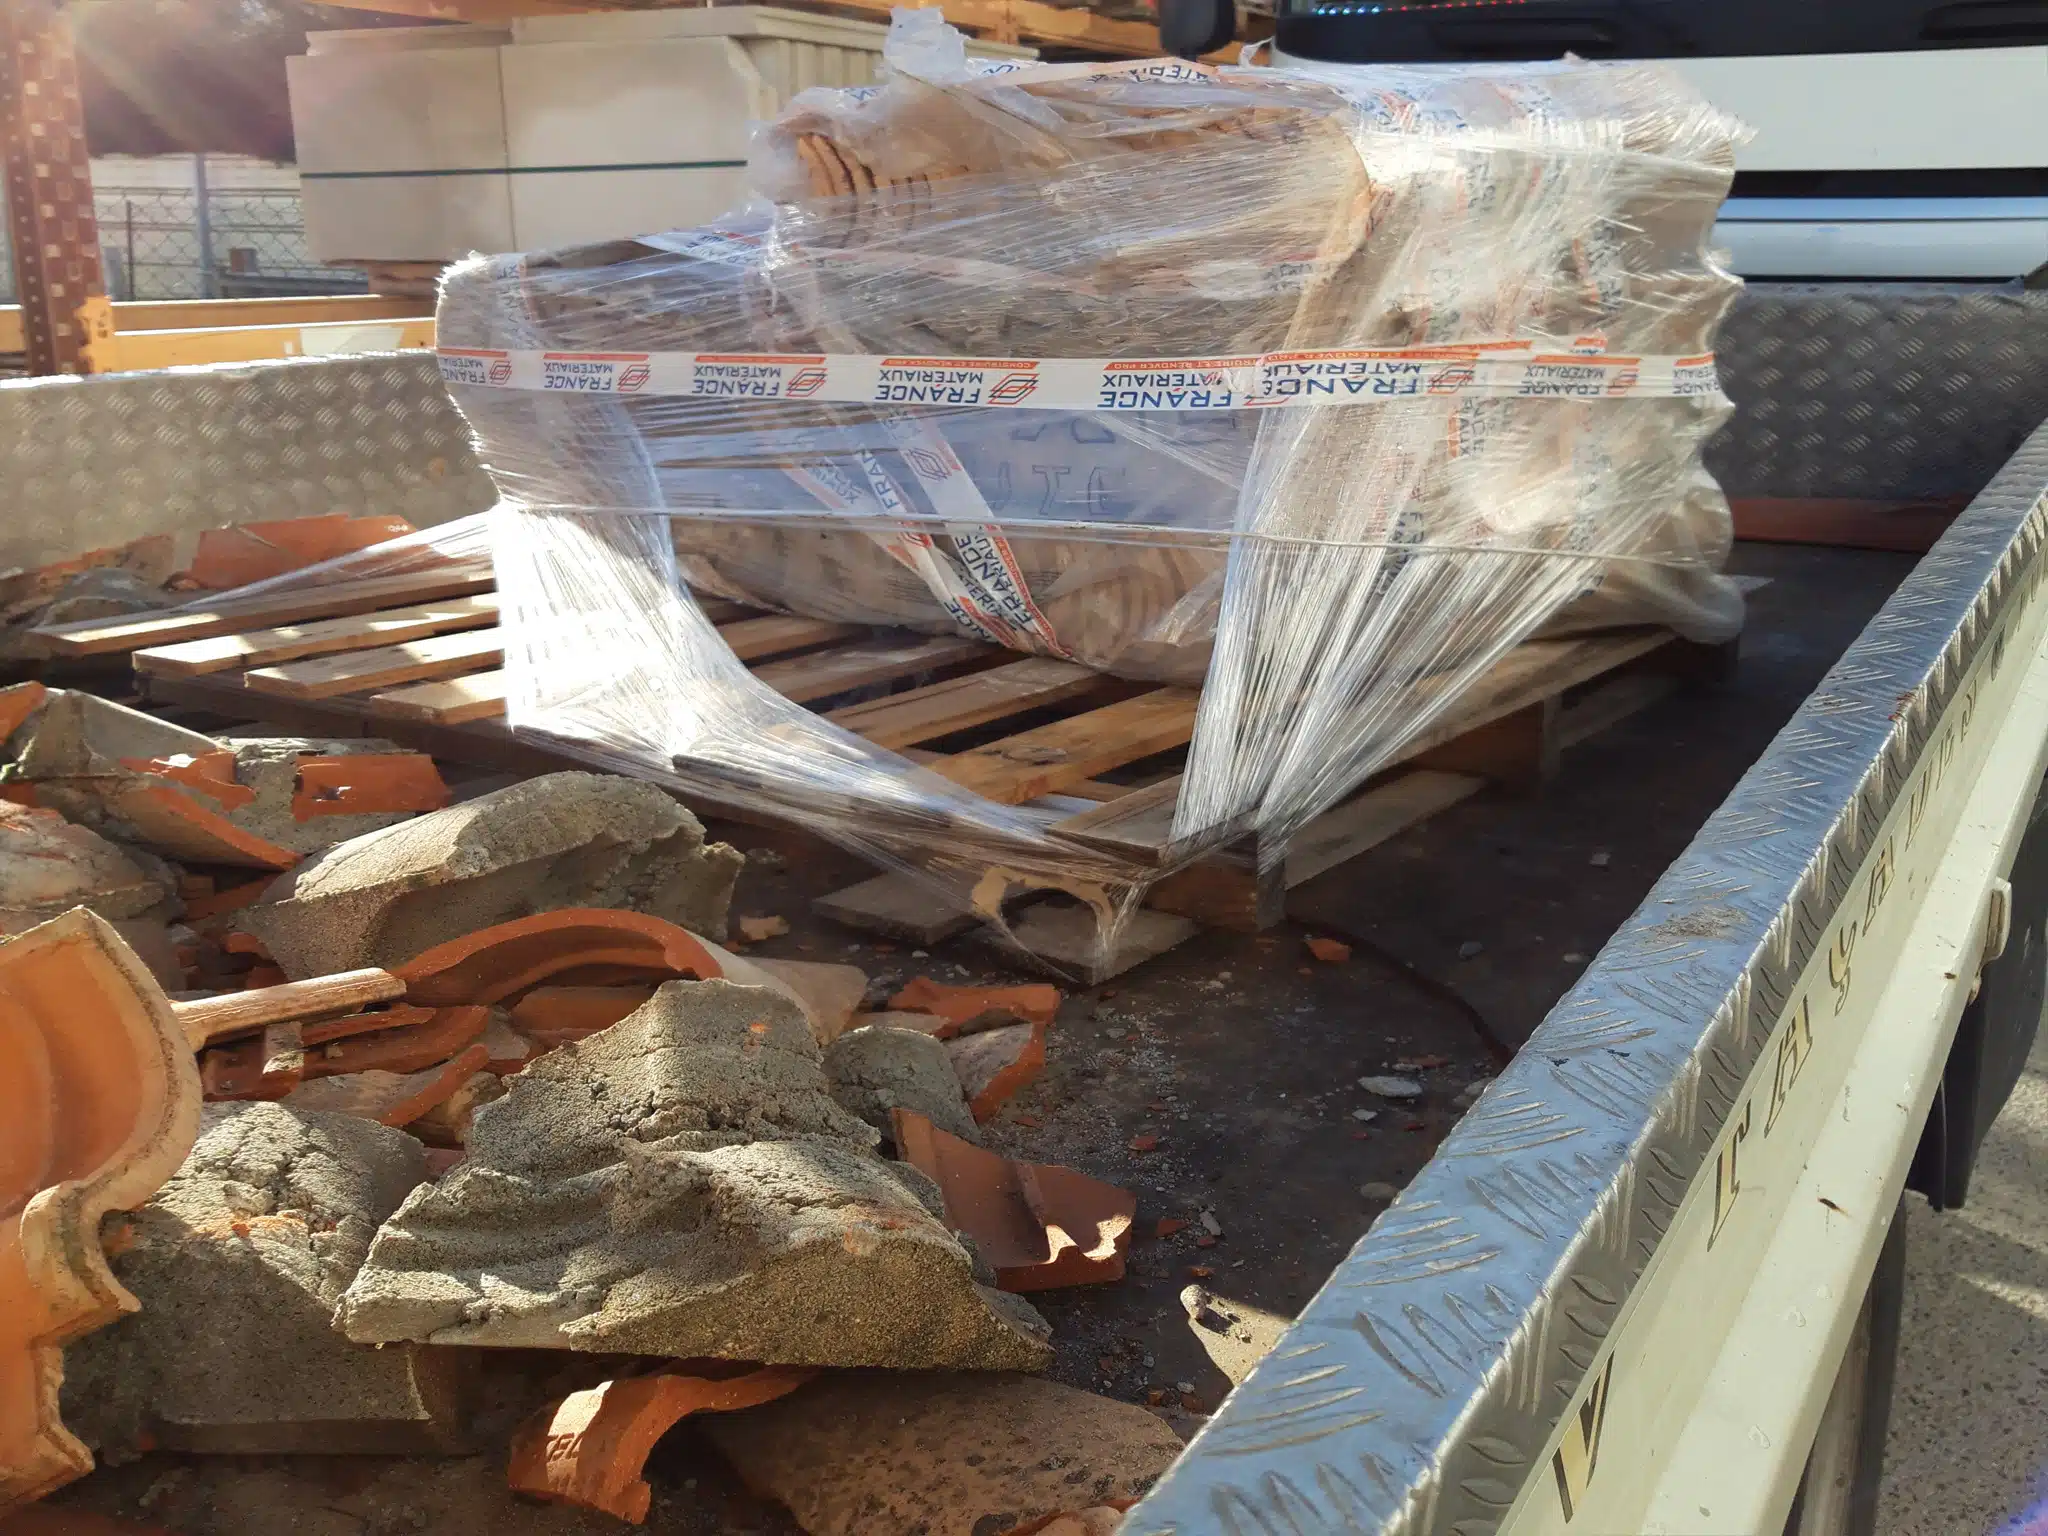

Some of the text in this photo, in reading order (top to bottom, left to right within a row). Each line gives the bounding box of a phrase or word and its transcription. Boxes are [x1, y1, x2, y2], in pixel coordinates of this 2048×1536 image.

[442, 367, 487, 384] FRANC
[545, 374, 612, 392] FRANCE
[879, 370, 984, 387] MATÉRIAUX
[1102, 372, 1225, 391] ATÉRIAUX
[692, 377, 781, 397] FRANCE
[875, 384, 981, 404] FRANCE
[1097, 390, 1232, 409] FRANCE
[955, 534, 1032, 625] FRANCE
